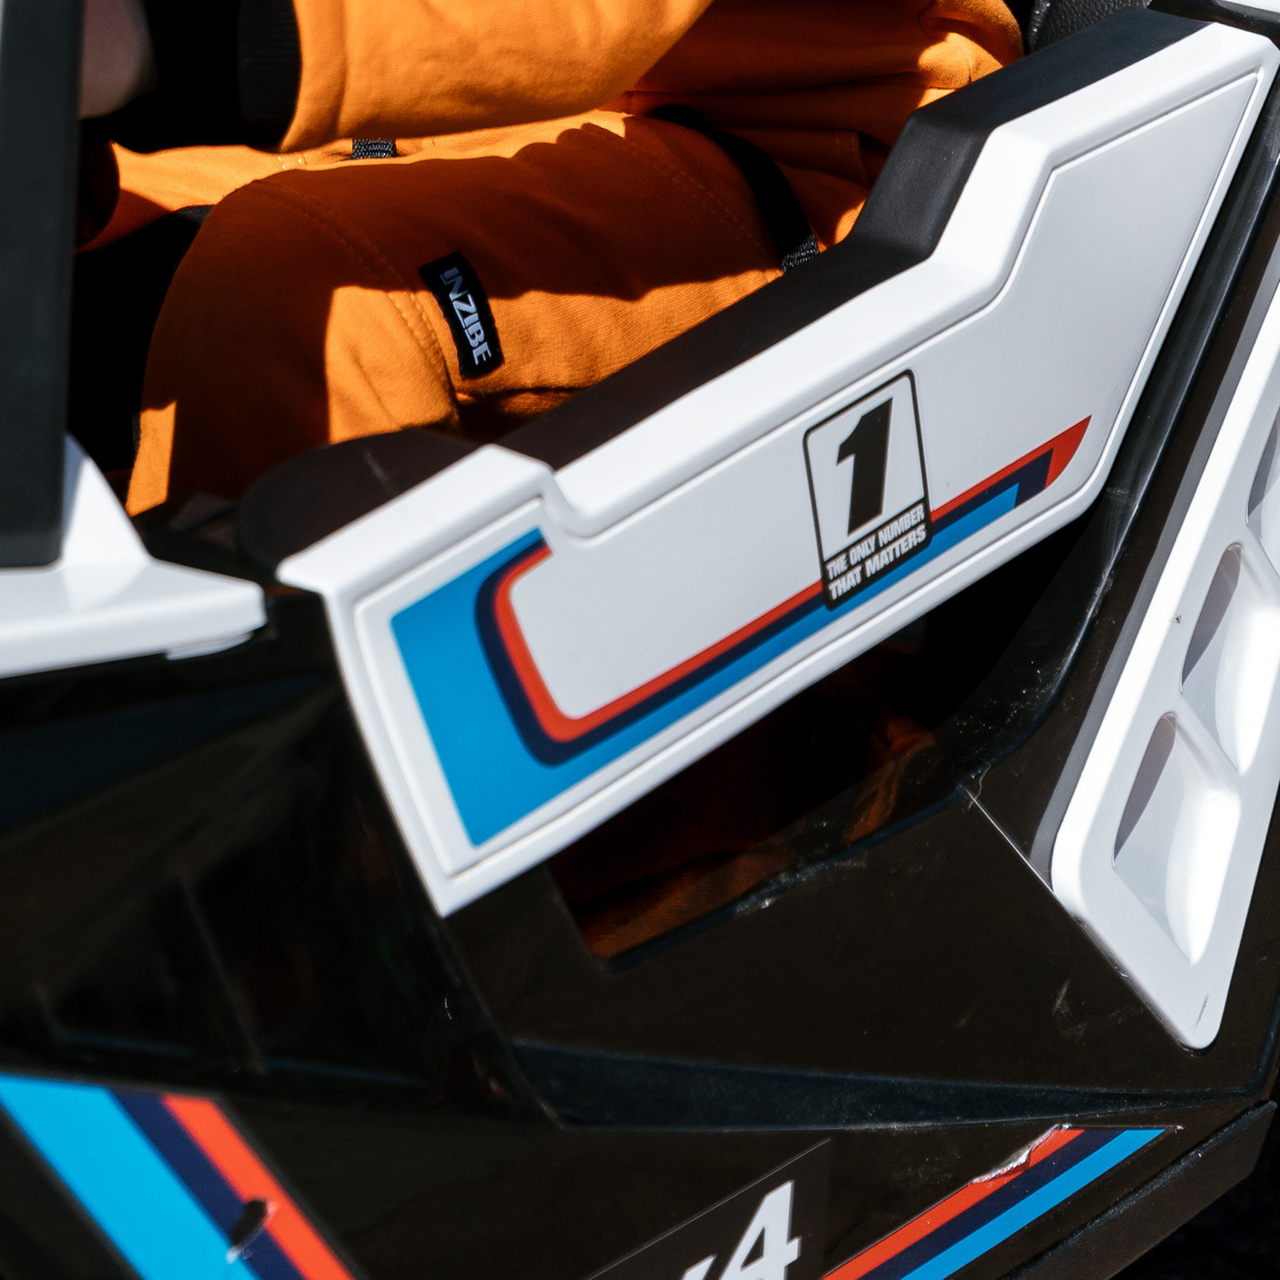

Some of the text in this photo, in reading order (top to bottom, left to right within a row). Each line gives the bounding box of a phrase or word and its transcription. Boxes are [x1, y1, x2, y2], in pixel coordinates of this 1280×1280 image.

[439, 266, 492, 366] INZIBE
[836, 396, 894, 538] 1
[826, 502, 925, 580] THE ONLY NUMBER
[828, 522, 927, 601] THAT MATTERS
